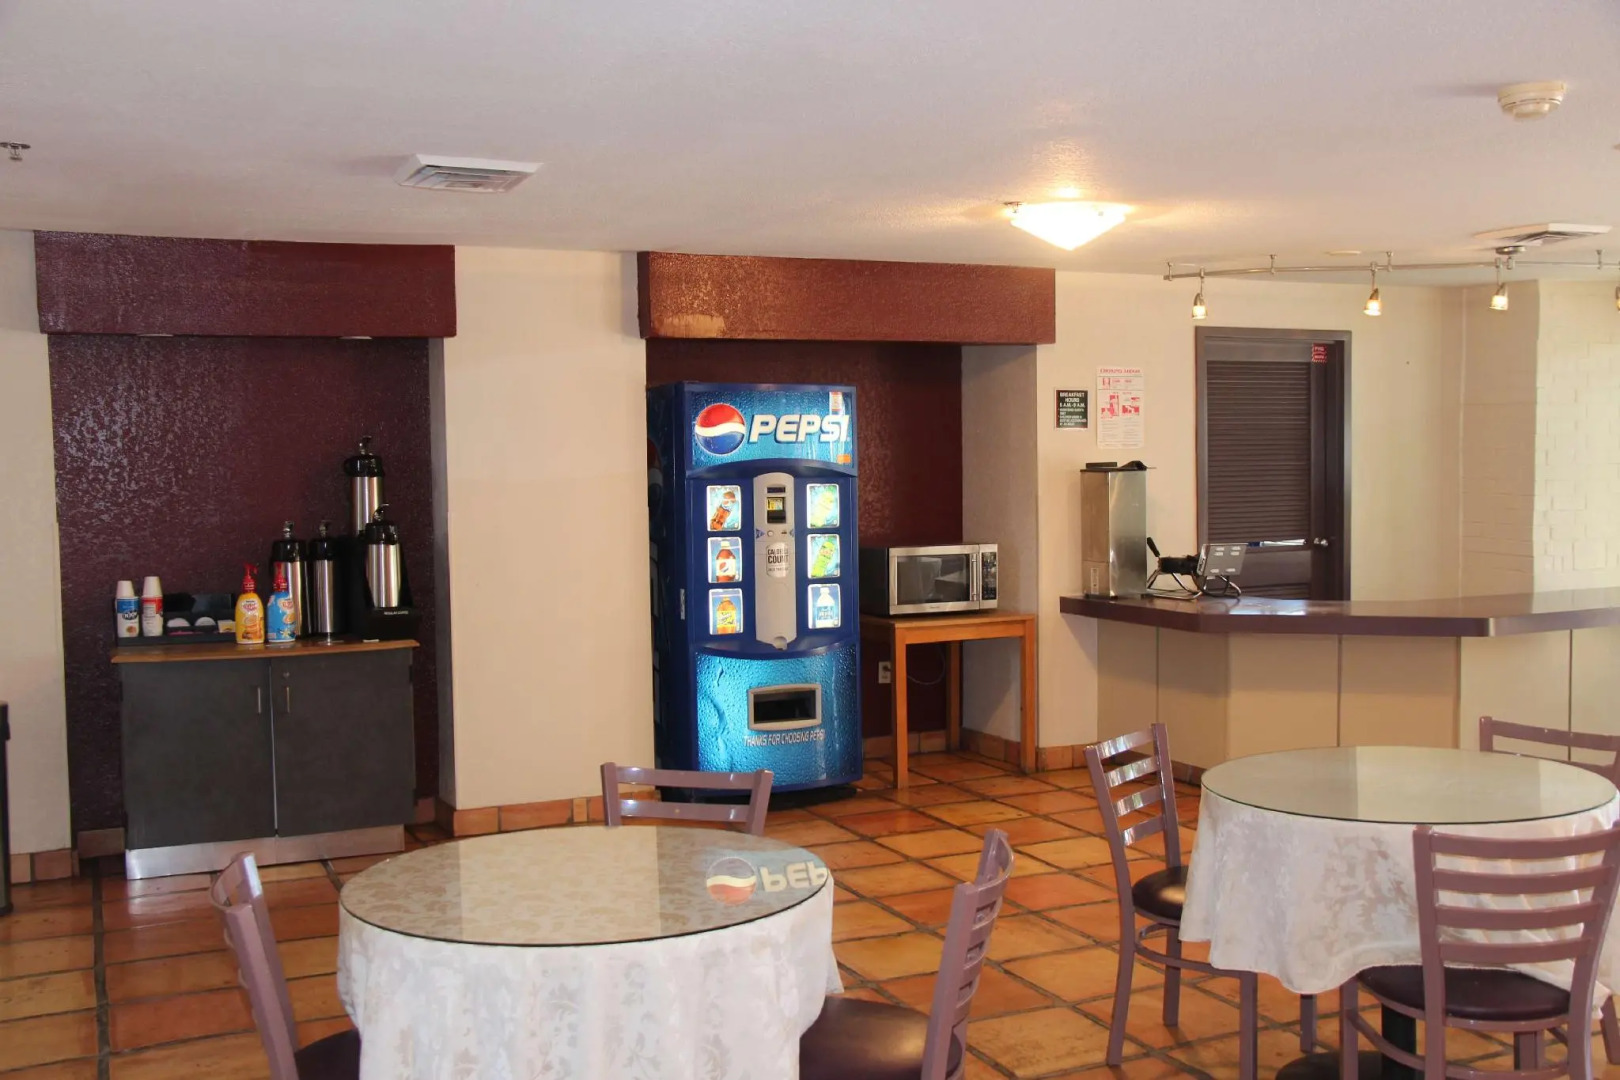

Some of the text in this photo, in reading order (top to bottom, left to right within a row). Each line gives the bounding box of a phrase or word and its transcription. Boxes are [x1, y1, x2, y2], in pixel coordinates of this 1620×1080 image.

[749, 414, 849, 443] PEPSI
[743, 735, 768, 747] THANKS
[768, 734, 780, 746] FOR
[781, 731, 808, 744] CHOOSING
